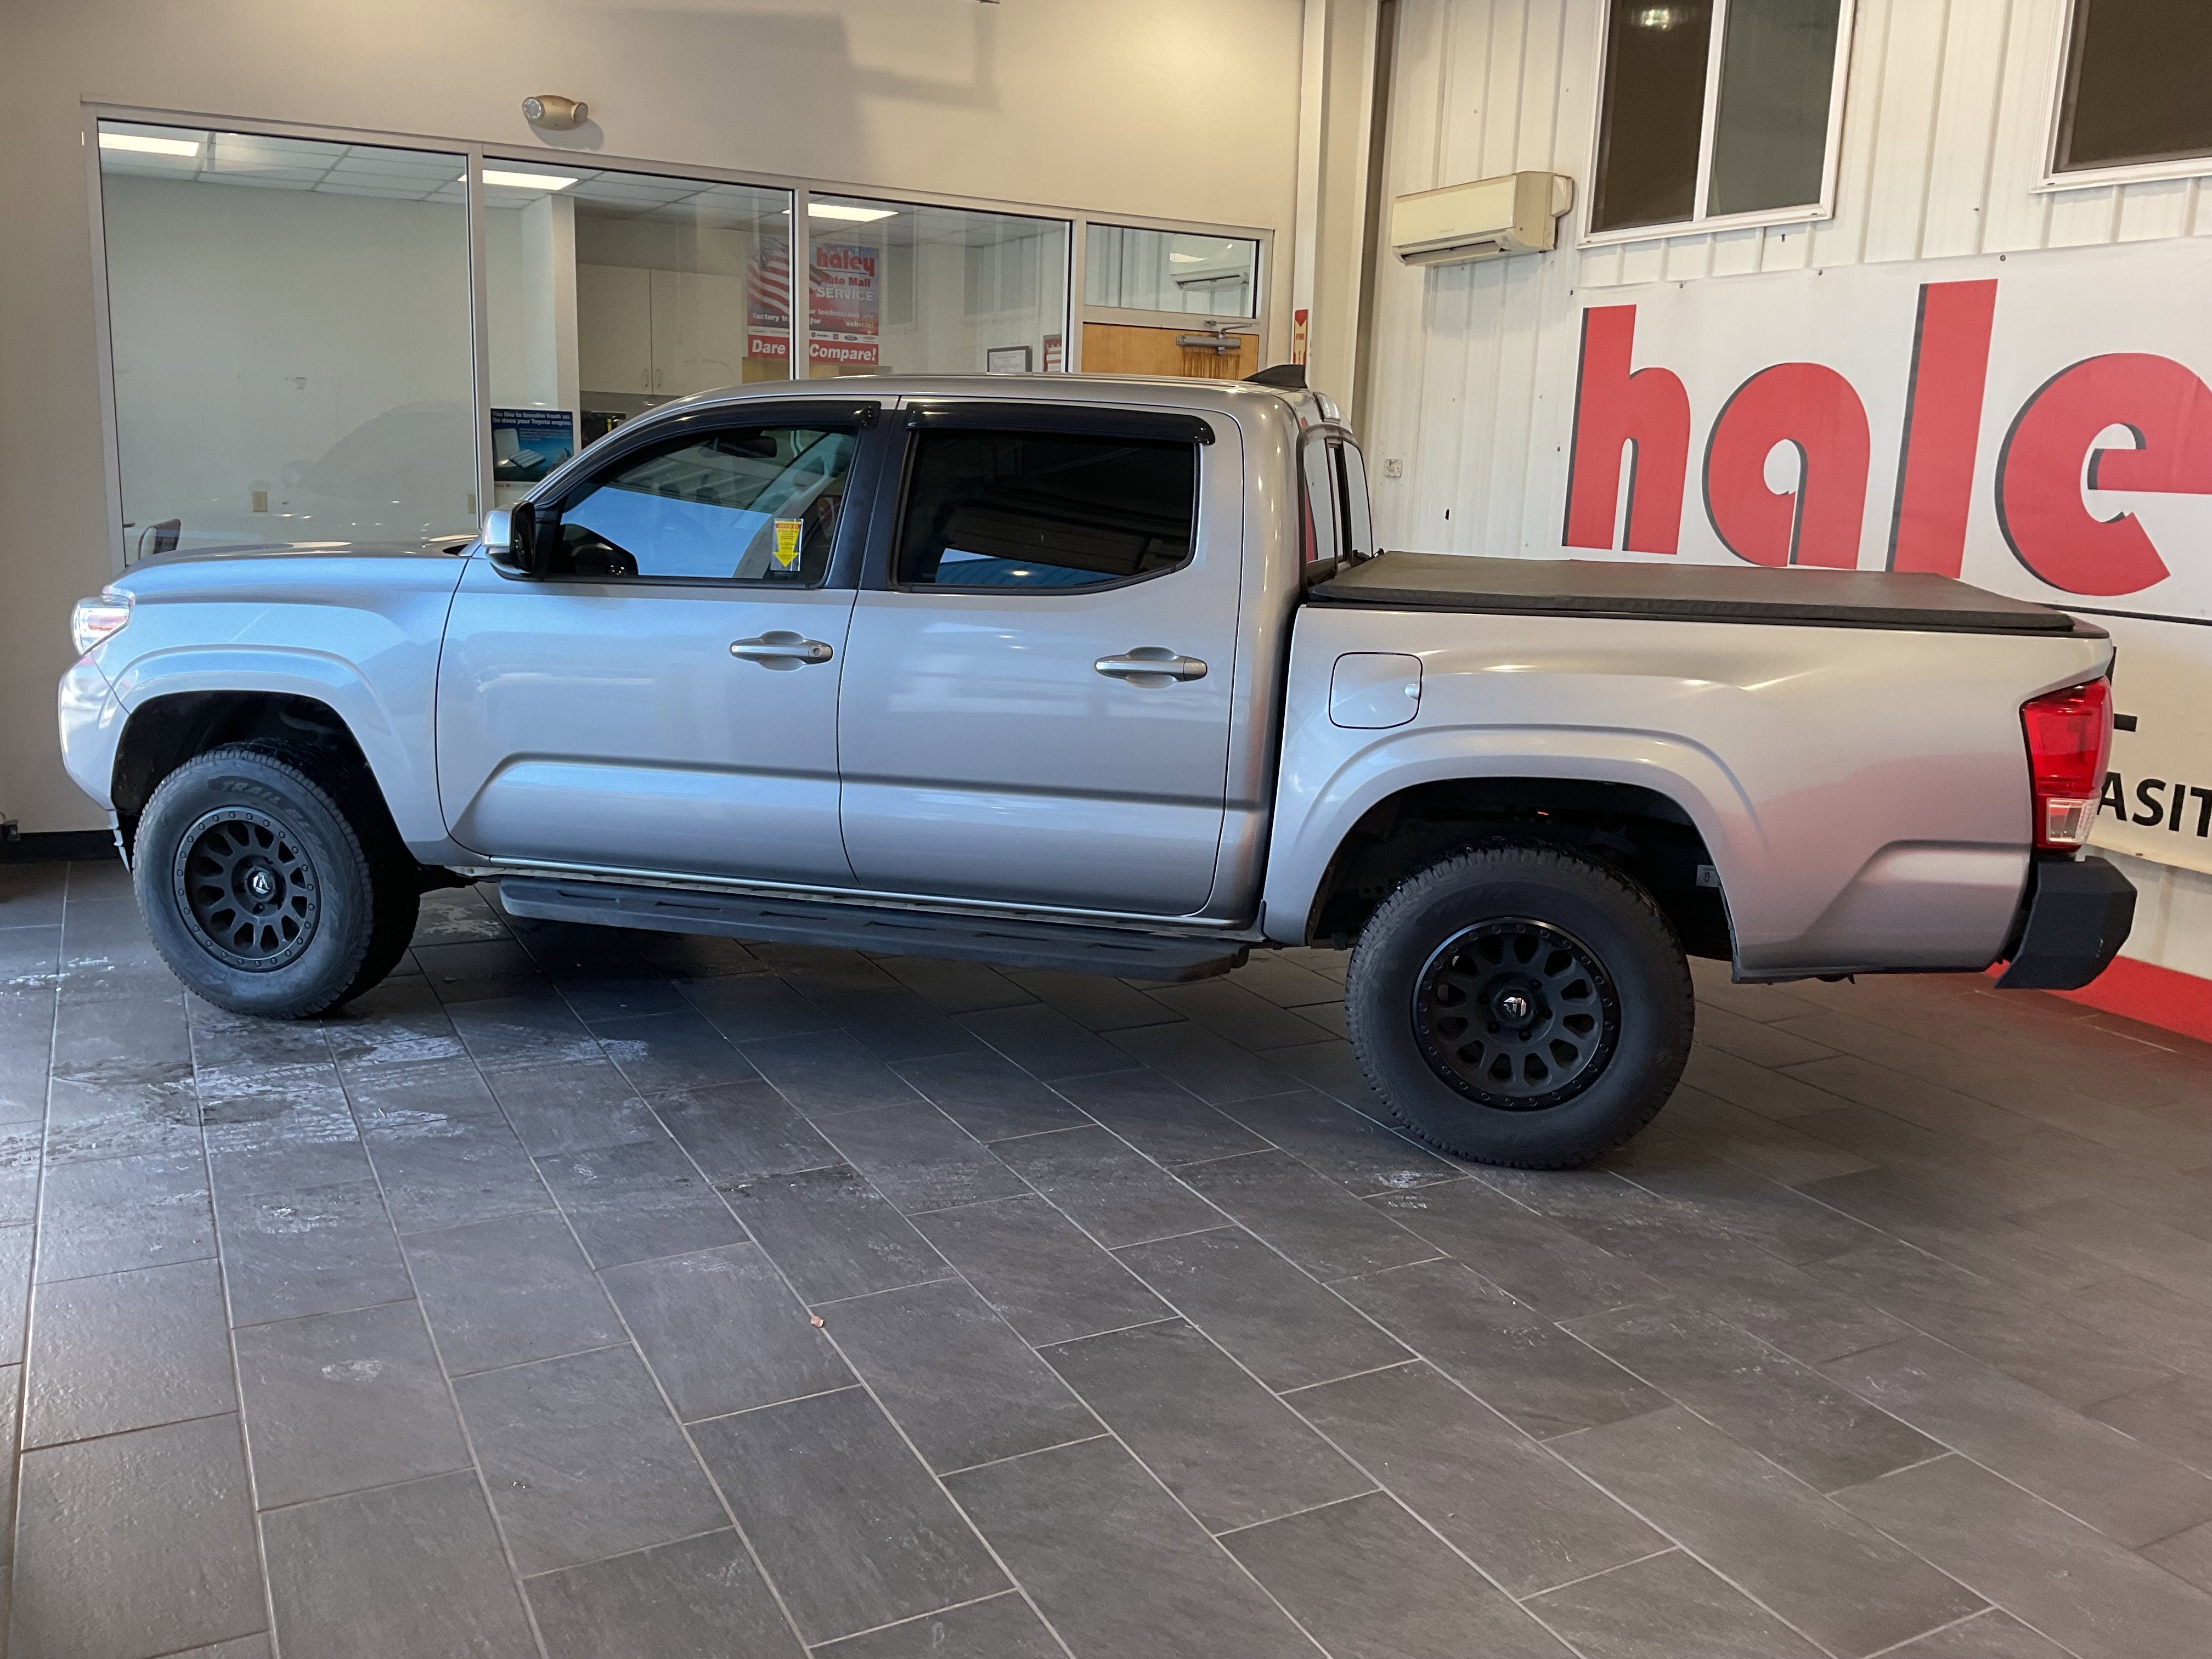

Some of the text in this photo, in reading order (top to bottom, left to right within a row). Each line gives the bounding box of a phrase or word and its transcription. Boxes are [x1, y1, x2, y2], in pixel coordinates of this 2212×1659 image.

[816, 247, 874, 277] haley
[849, 276, 870, 287] Mall
[816, 286, 873, 302] SERVICE
[753, 312, 779, 322] factory
[818, 309, 860, 318] technicians
[752, 339, 877, 362] Dare Compare!
[222, 781, 281, 804] TRAIL
